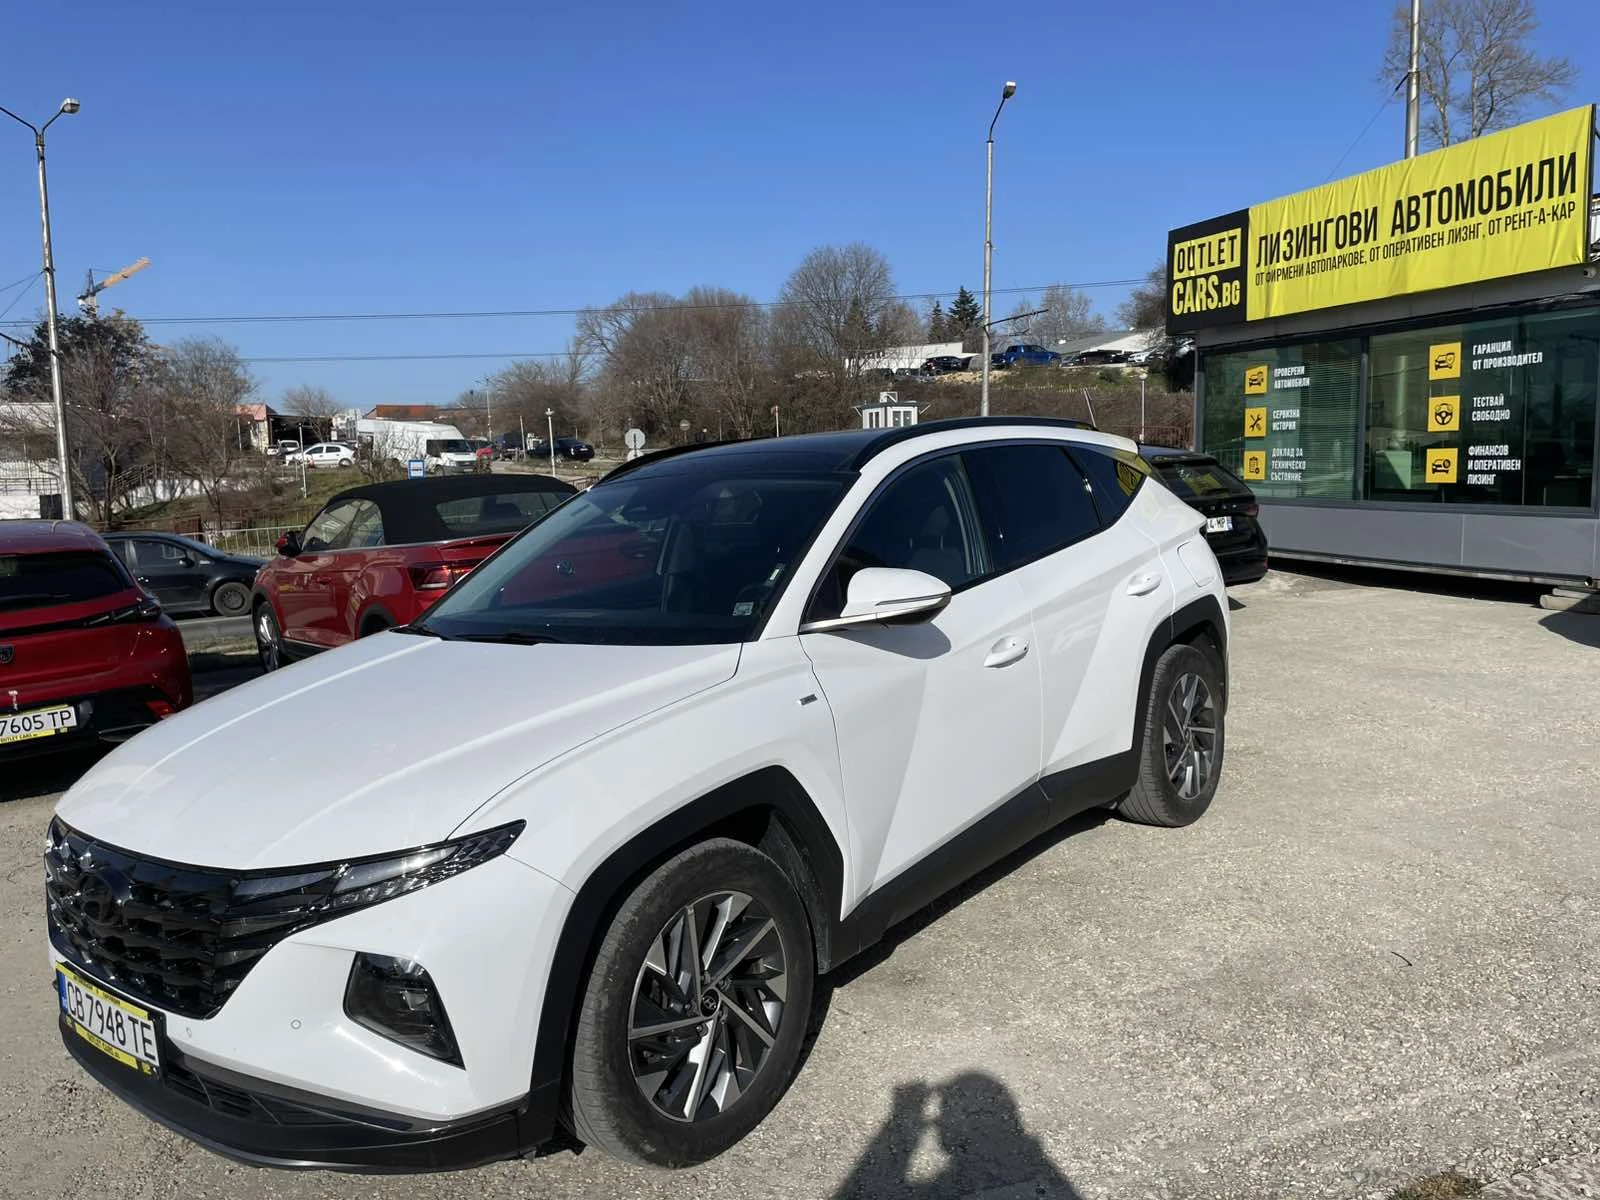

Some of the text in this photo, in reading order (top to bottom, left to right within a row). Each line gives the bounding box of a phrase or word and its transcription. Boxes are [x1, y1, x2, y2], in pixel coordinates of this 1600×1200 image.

[1256, 151, 1577, 268] ЛИЗИНГОВИ АВТОМОБИЛИ
[1255, 271, 1265, 286] ОТ
[1265, 263, 1304, 283] ФИРМЕНИ
[1369, 246, 1381, 262] ОТ
[1382, 233, 1445, 260] ОПЕРАТИВЕН
[1488, 217, 1502, 236] ОТ
[1504, 201, 1576, 232] РЕНТ-А-КАР
[1177, 235, 1237, 273] OUTLET
[1172, 274, 1241, 315] CARS.BG
[1472, 340, 1511, 355] ГАРАНЦИЯ
[1472, 351, 1543, 370] ОТ ПРОИЗВОДИТЕЛ
[1273, 366, 1305, 377] ПРОВЕРЕНИ
[1273, 377, 1310, 389] АВТОМОБИЛИ
[1472, 393, 1504, 407] ТЕСТВАЙ
[1471, 409, 1511, 421] СВОБОДНО
[1272, 447, 1303, 458] ДОКЛАД ЗА
[1467, 444, 1510, 456] ФИНАНСОВ
[1467, 459, 1521, 470] И ОПЕРАТИВЕН
[1467, 473, 1496, 485] ЛИЗИНГ
[47, 710, 72, 727] TP
